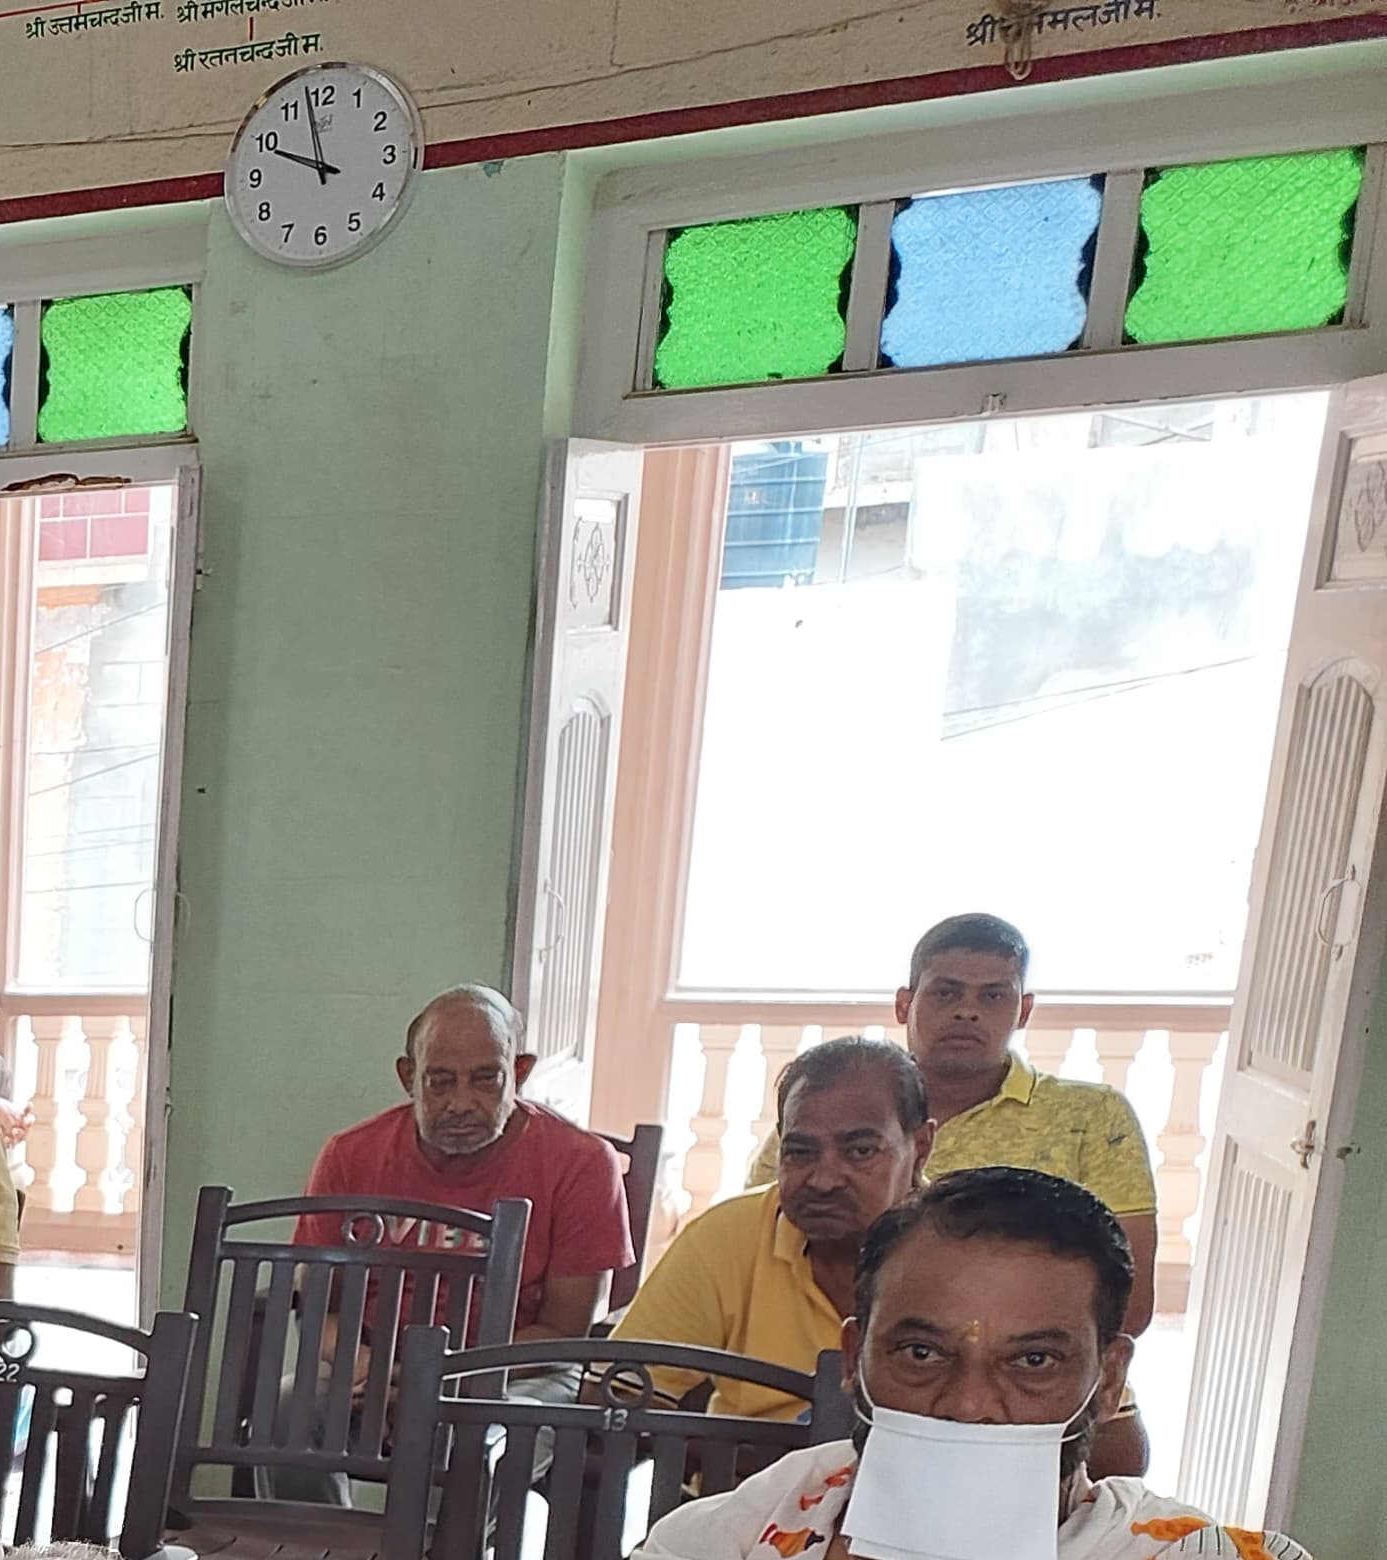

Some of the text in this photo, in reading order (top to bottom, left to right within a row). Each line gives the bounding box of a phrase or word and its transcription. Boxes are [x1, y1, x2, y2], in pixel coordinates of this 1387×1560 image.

[310, 85, 336, 107] 12
[352, 88, 363, 109] 1
[280, 101, 300, 122] 11
[373, 111, 388, 132] 2
[254, 131, 278, 153] 10
[382, 145, 397, 165] 3
[249, 168, 263, 189] 9
[371, 182, 387, 203] 4
[258, 201, 272, 222] 8
[346, 212, 362, 233] 5
[280, 223, 296, 244] 7
[313, 226, 328, 246] 6
[601, 1407, 629, 1432] 13
